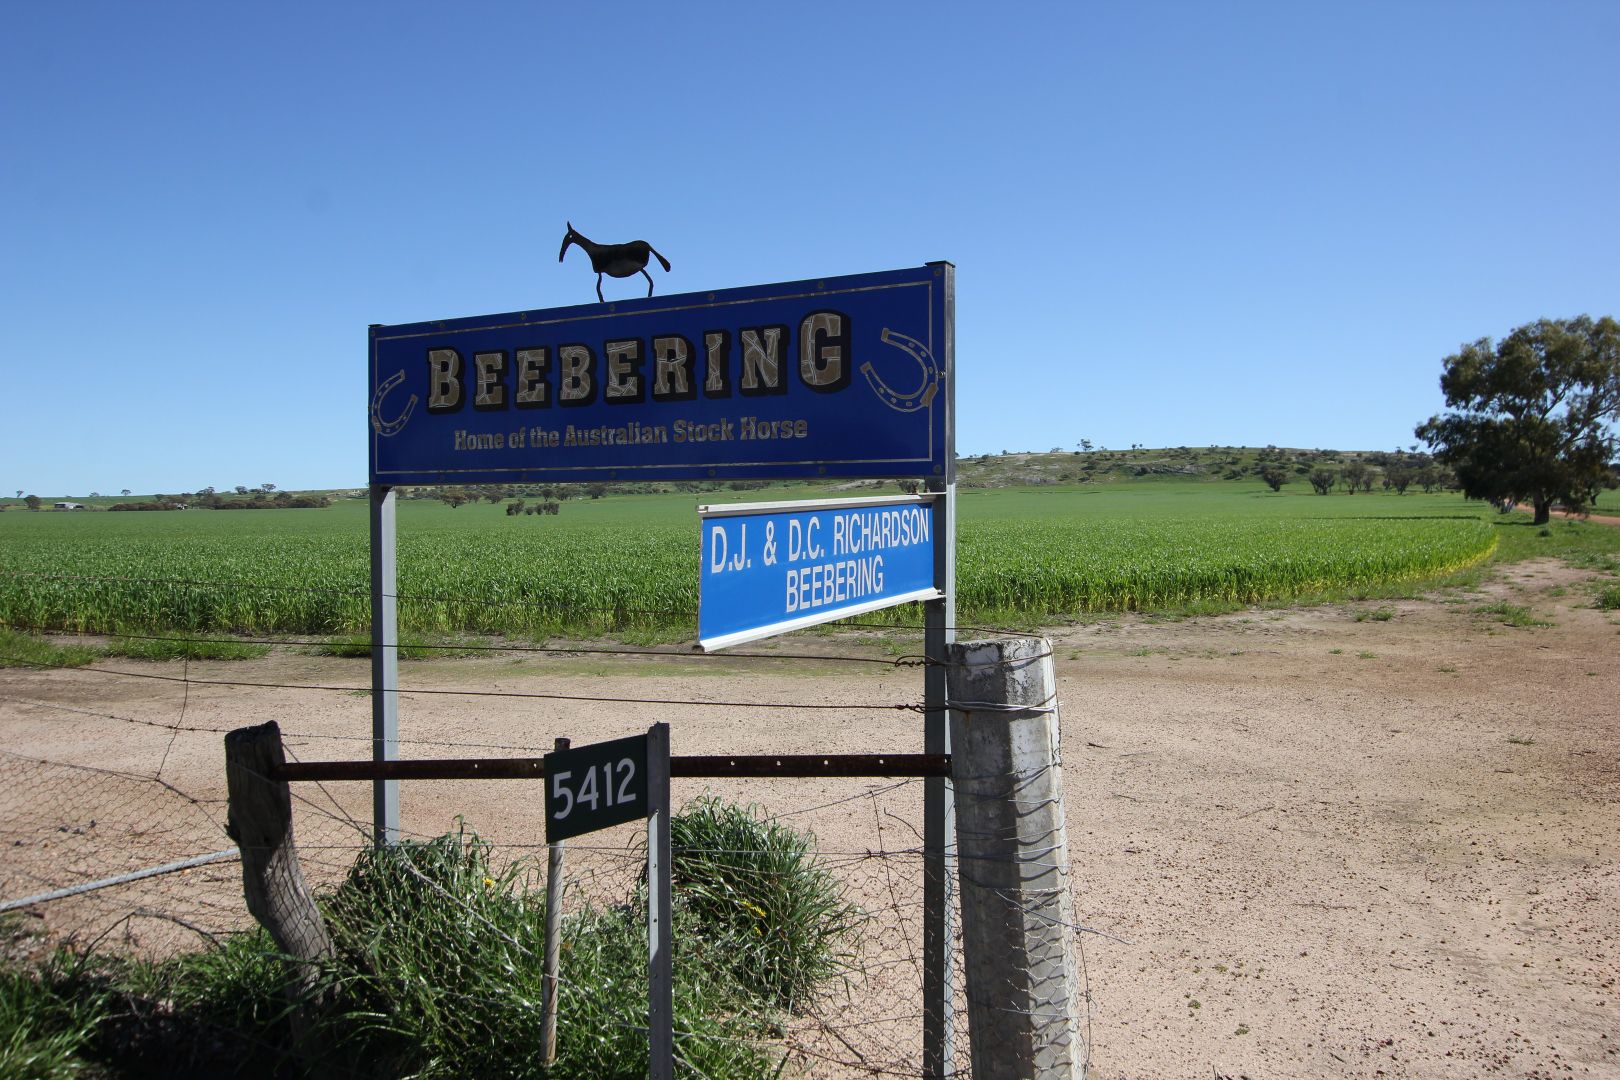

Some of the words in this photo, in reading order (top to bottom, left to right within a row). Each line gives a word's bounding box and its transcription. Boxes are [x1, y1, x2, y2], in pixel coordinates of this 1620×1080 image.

[428, 311, 842, 408] BEEBERING
[454, 429, 504, 451] Home
[508, 428, 526, 449] of
[529, 427, 559, 448] the
[563, 421, 667, 447] Australian
[673, 417, 734, 443] Stock
[740, 416, 808, 440] Horse
[711, 523, 751, 574] D.J.
[763, 520, 777, 566] &
[788, 516, 825, 562] D.C.
[833, 507, 929, 556] RICHARDSON
[786, 554, 883, 613] BEEBERING
[553, 757, 636, 820] 5412
